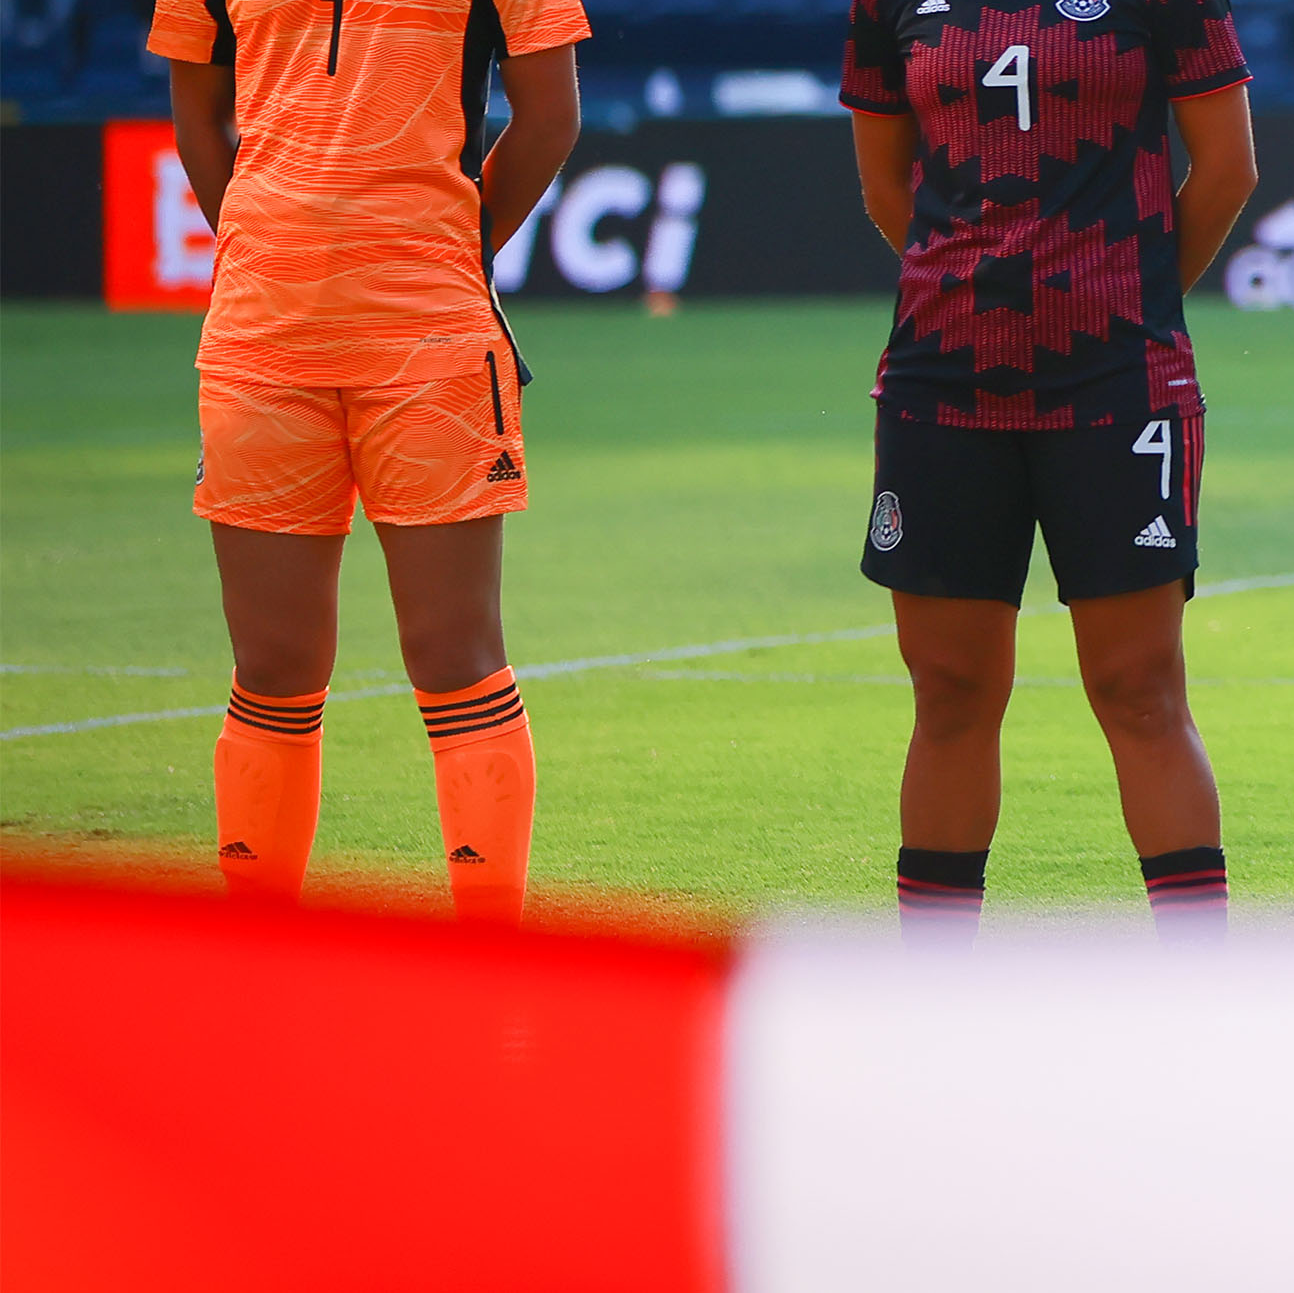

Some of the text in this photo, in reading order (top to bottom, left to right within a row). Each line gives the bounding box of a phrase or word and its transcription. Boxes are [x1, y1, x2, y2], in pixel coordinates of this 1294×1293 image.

[916, 3, 951, 15] adidas
[982, 44, 1031, 132] 4
[484, 350, 505, 436] 1
[486, 468, 521, 483] adidas
[1132, 419, 1172, 500] 4
[1134, 533, 1177, 549] adidas
